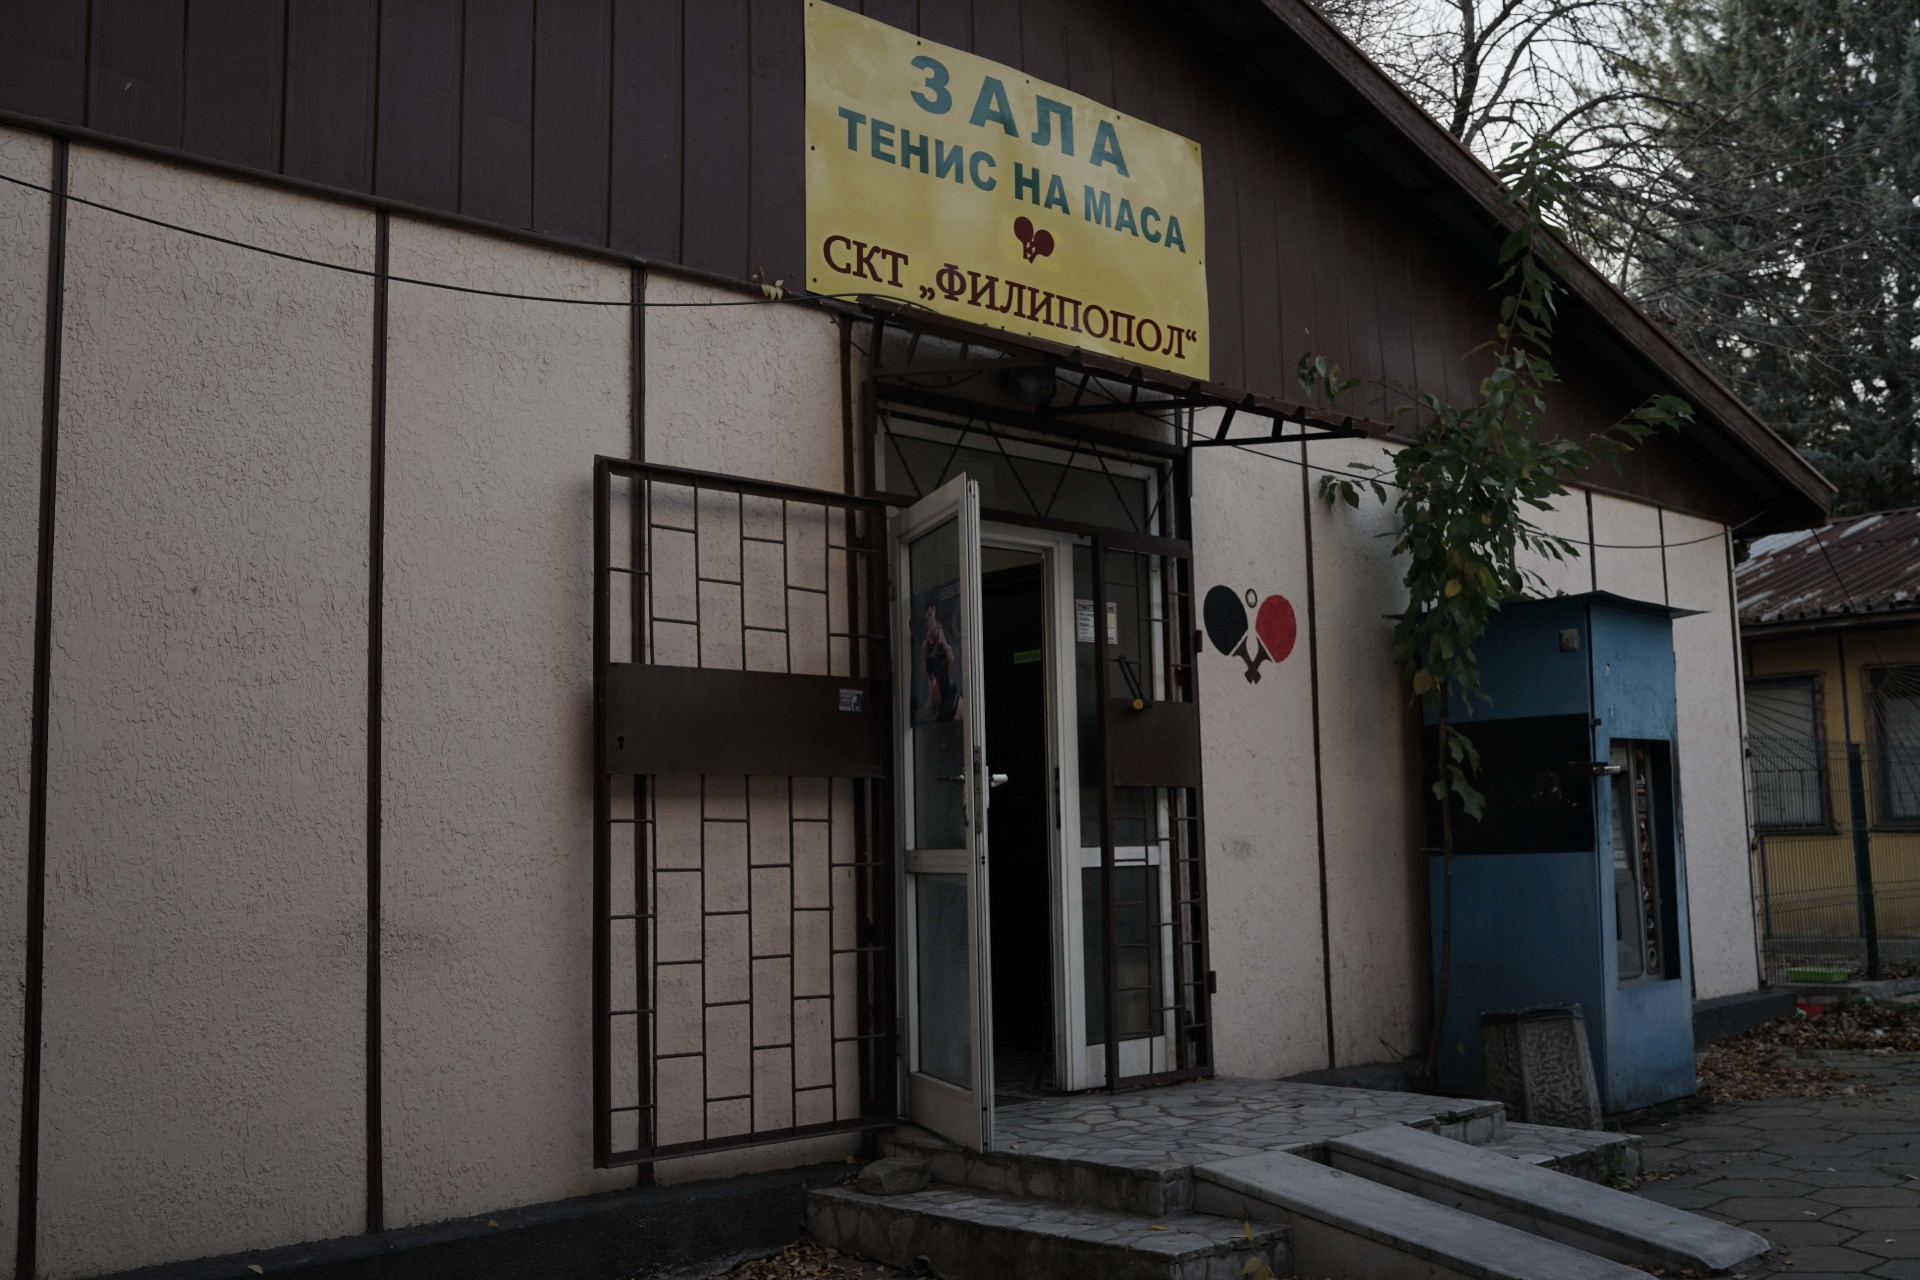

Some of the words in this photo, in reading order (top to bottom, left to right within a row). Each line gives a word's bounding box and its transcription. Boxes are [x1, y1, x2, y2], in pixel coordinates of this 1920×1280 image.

[909, 55, 1130, 178] ЗАЛА
[838, 106, 997, 192] ТЕНИС
[1013, 161, 1071, 216] НА
[1083, 184, 1187, 254] МАСА
[822, 235, 909, 288] СКТ
